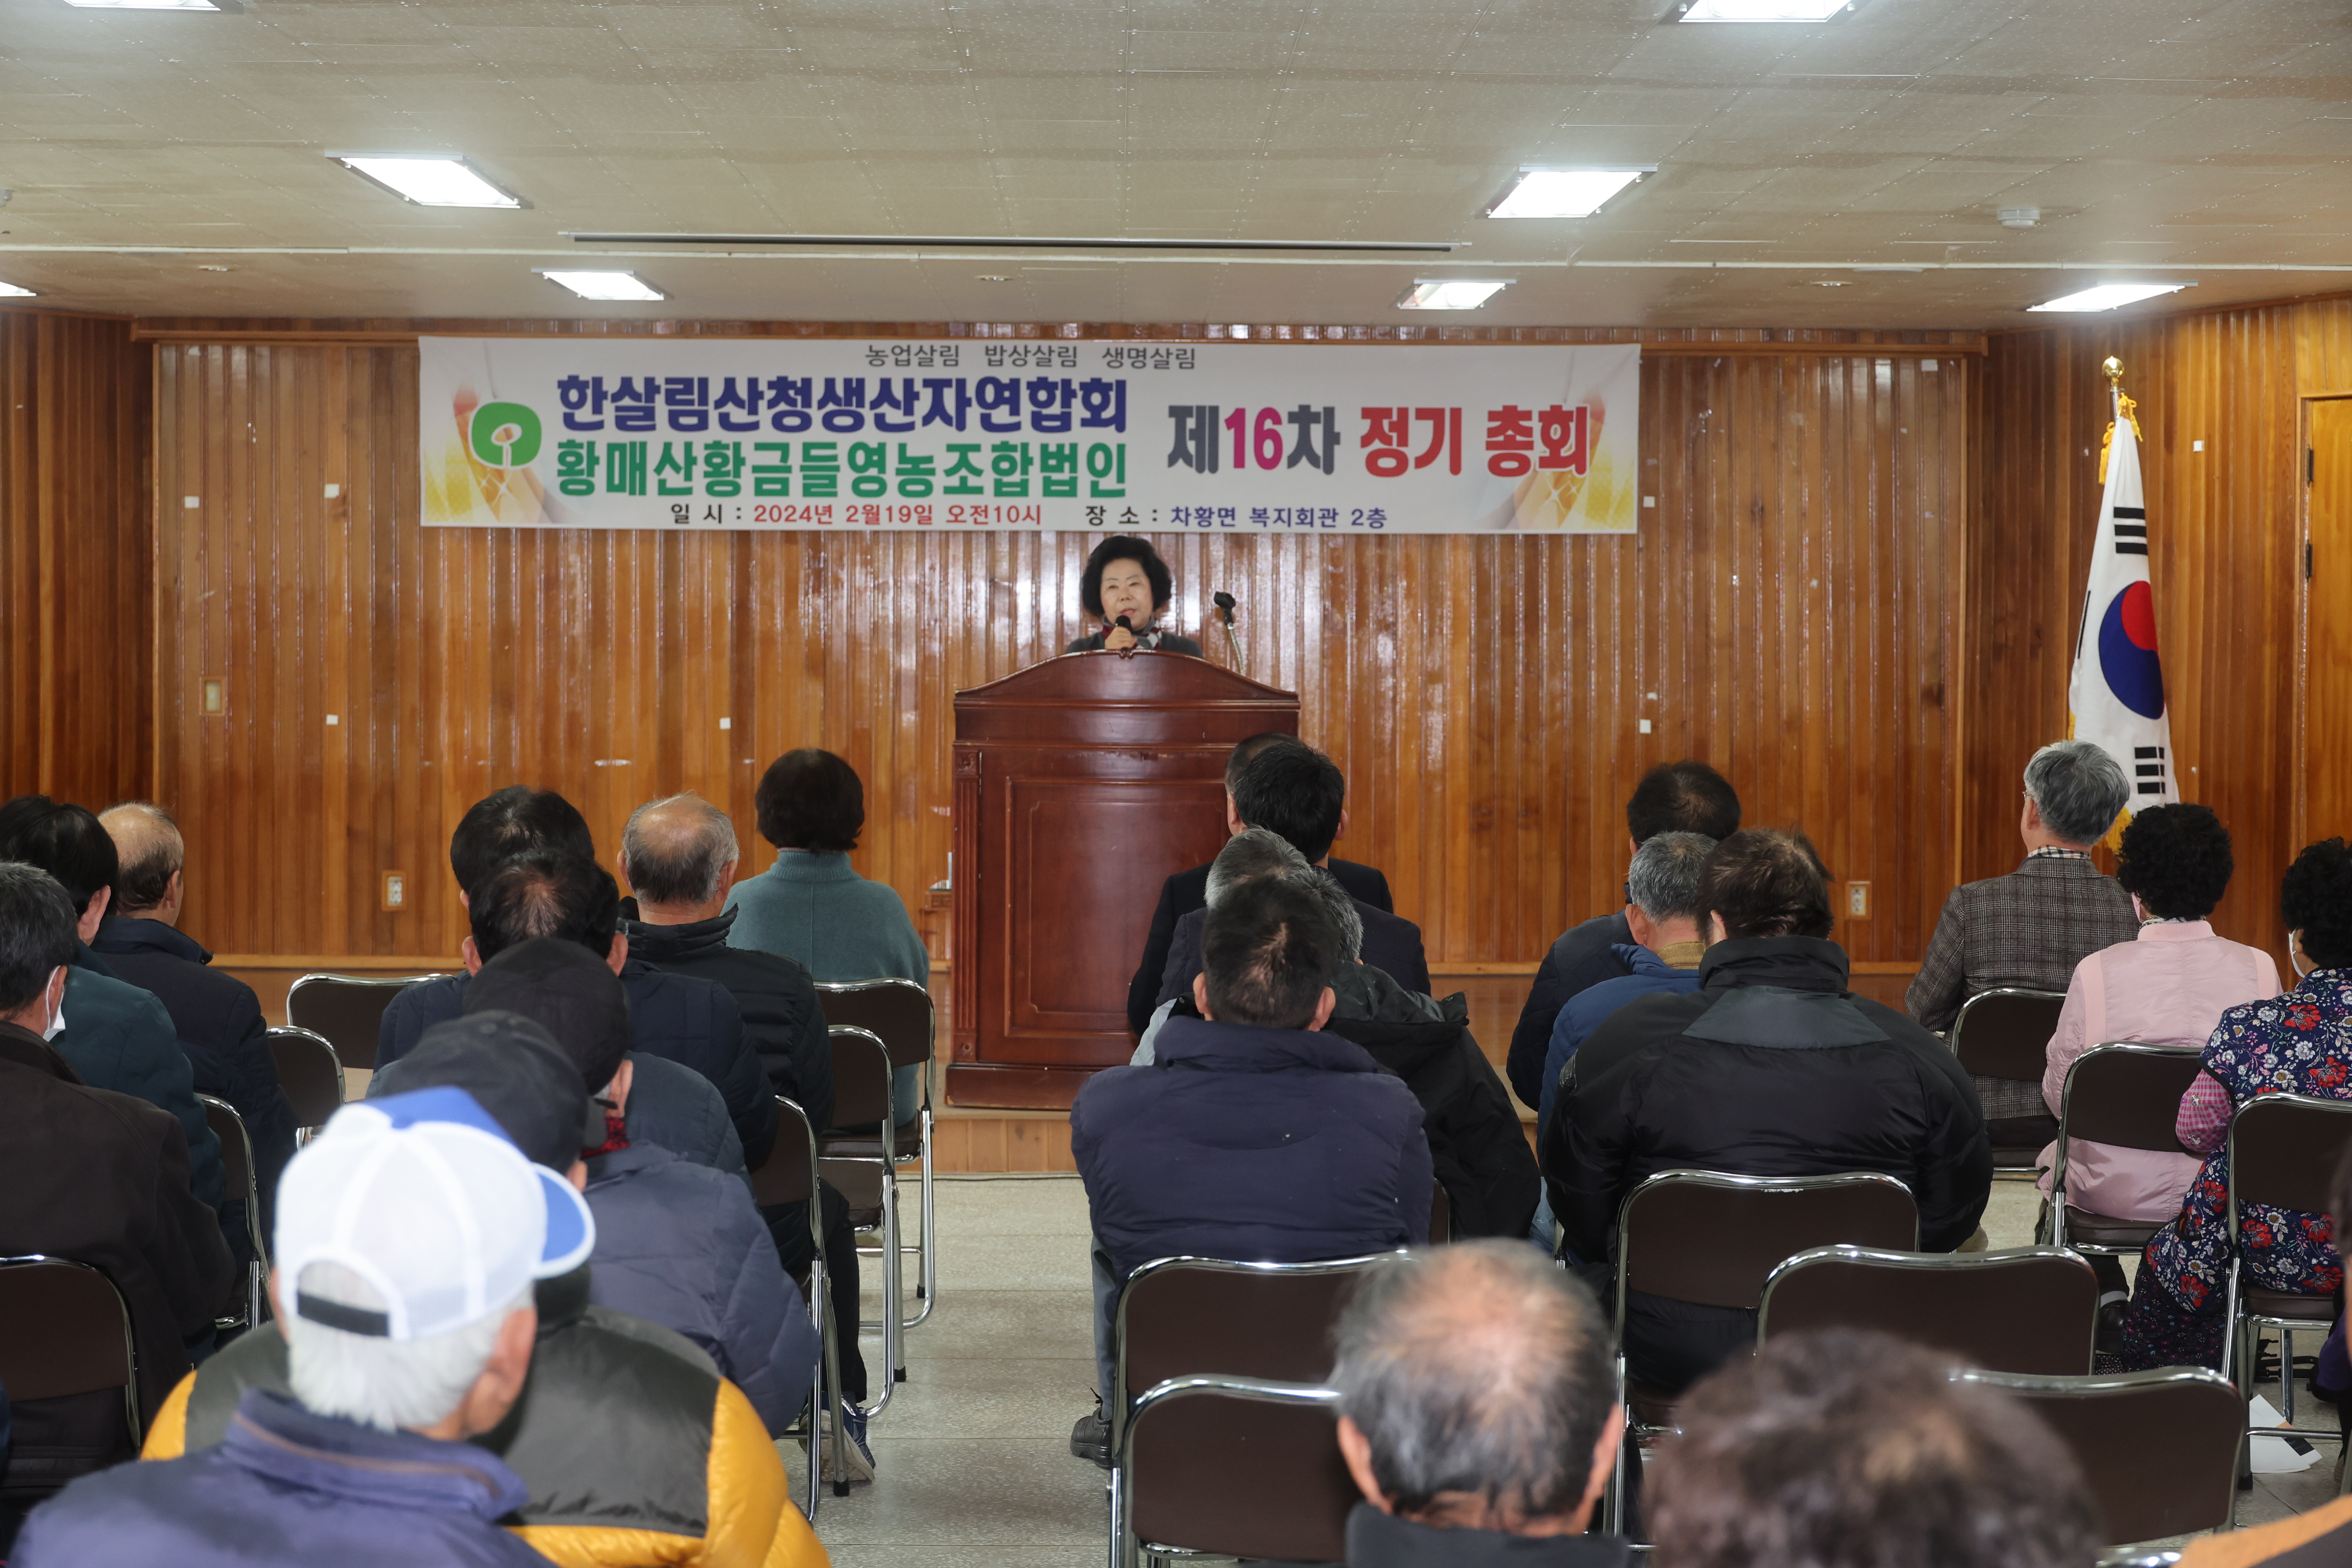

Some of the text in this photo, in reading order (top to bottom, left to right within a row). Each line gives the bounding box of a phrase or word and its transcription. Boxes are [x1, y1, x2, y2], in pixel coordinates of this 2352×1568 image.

[866, 345, 1194, 369] 농업살림 밥상살림 생명살림
[558, 375, 1126, 433] 한살림산청생산자연합회
[1168, 405, 1588, 477] 제16차 정기 총회
[557, 439, 1125, 498] 황매산황금들영농조합법인
[755, 505, 832, 524] 2024년
[846, 505, 932, 525] 2월19일
[946, 505, 1040, 524] 오전10시
[1172, 507, 1235, 527] 차황면
[1250, 508, 1338, 527] 복지회관
[1352, 508, 1387, 528] 2층
